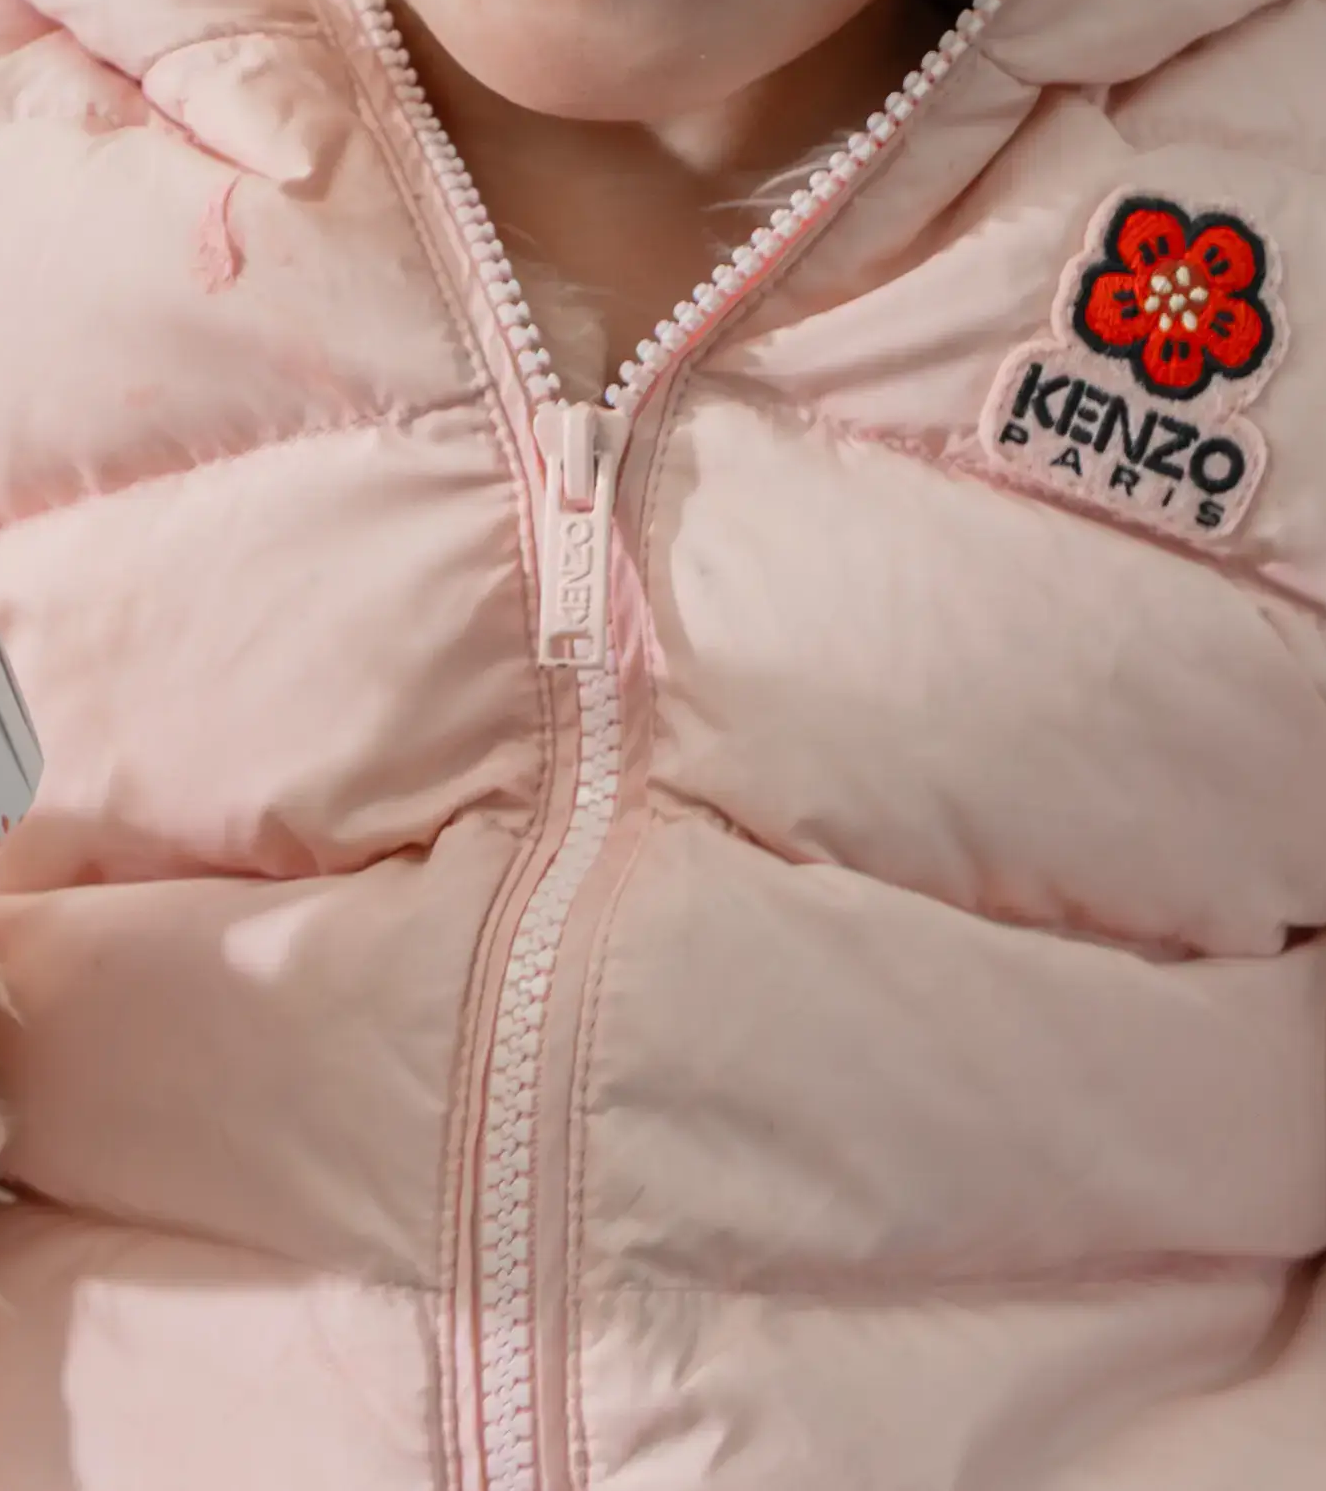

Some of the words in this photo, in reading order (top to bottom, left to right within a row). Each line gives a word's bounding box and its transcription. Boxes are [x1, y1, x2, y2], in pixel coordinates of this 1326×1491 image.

[998, 422, 1226, 530] PARIS
[1011, 362, 1246, 495] KENZO
[558, 517, 594, 627] KENZO
